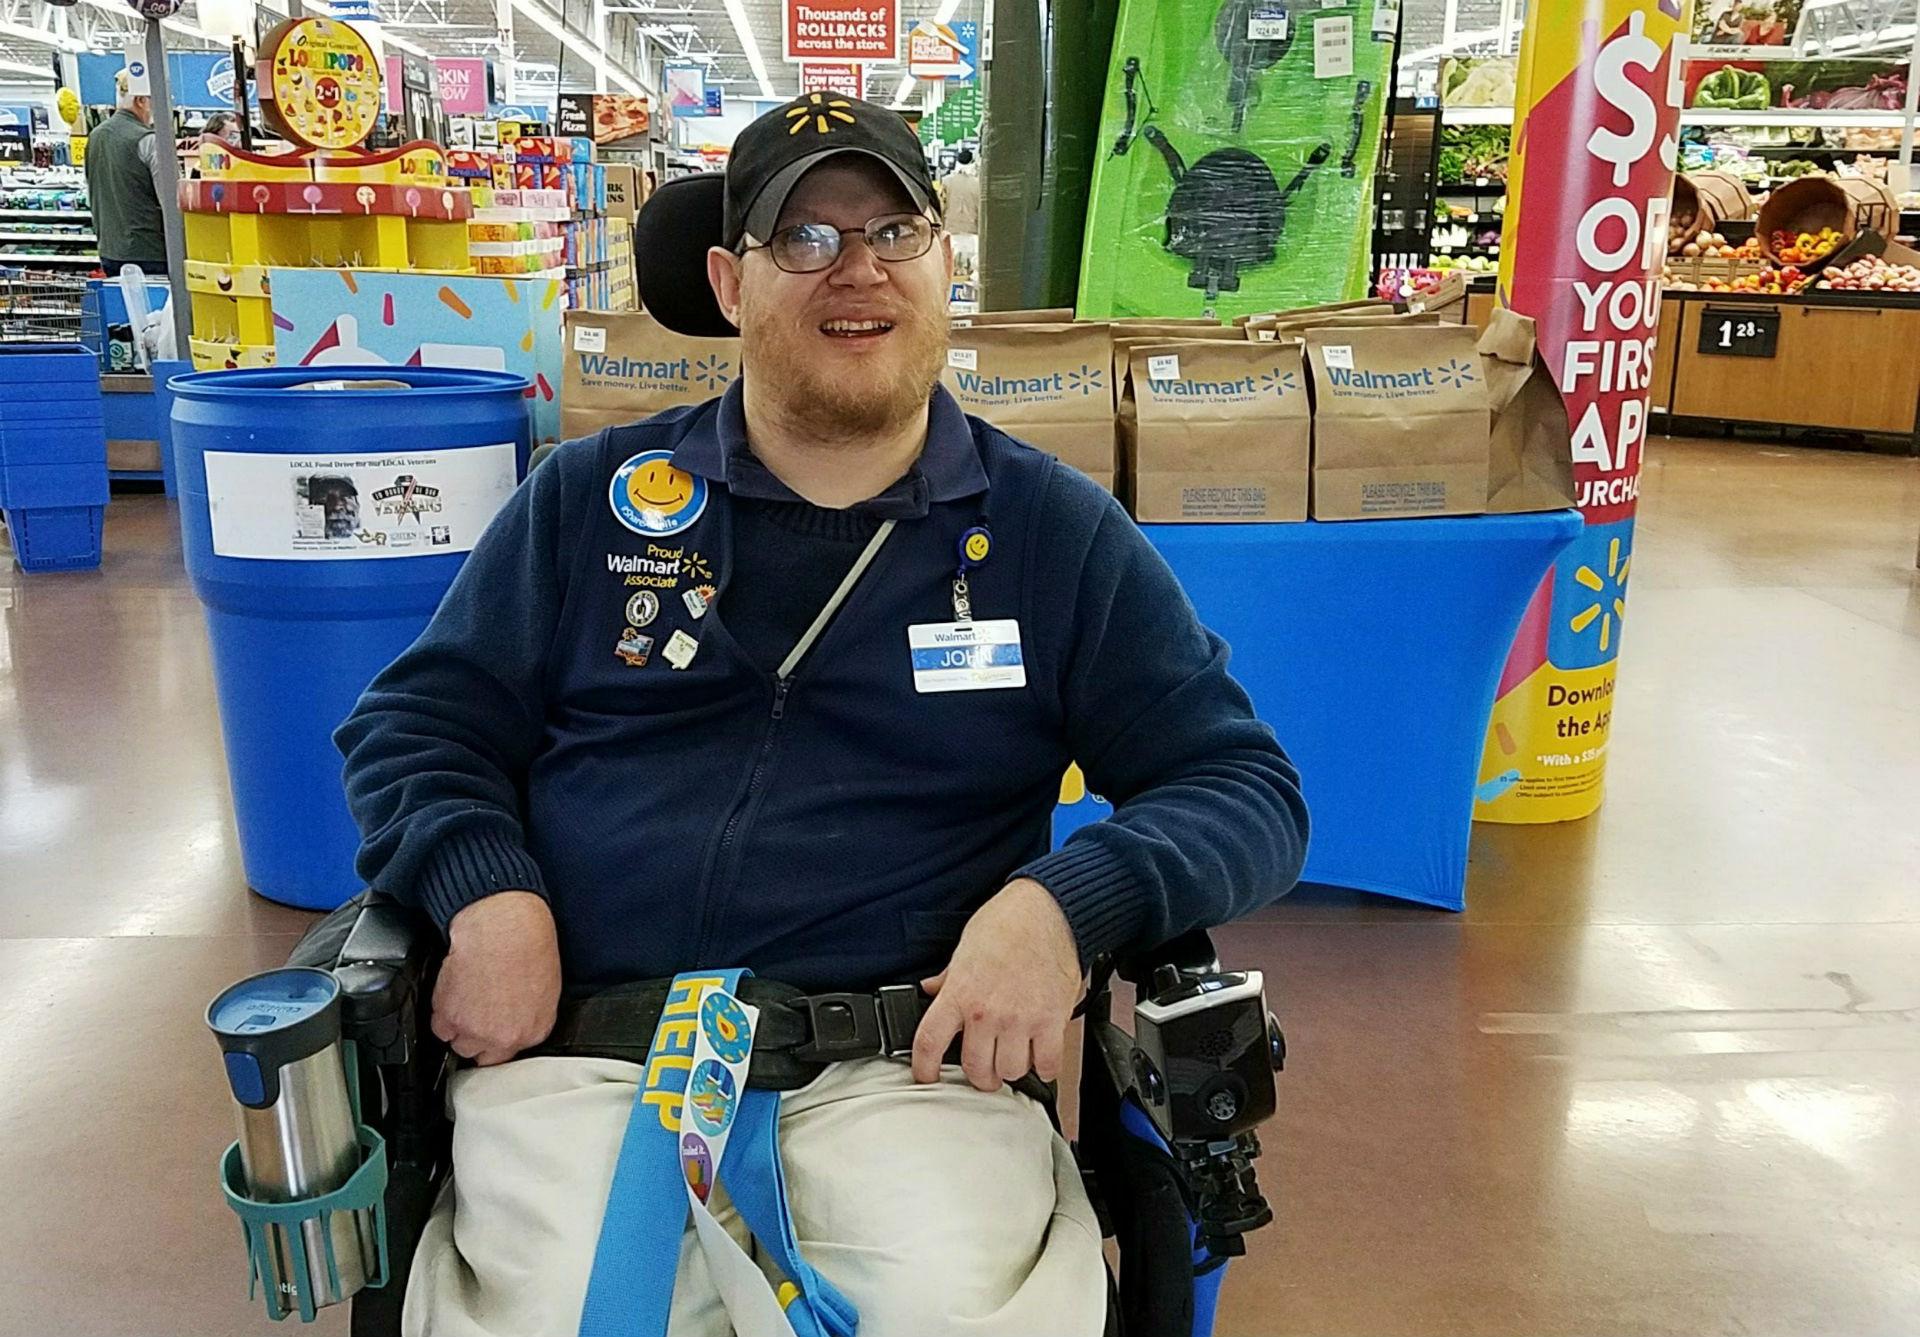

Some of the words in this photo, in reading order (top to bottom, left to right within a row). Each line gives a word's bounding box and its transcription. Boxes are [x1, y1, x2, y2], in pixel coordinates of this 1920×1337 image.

[797, 6, 867, 21] Thousands
[870, 8, 887, 21] of
[797, 22, 887, 37] ROLLBACKS
[797, 39, 833, 49] across
[835, 38, 854, 49] the
[856, 39, 887, 50] store.
[805, 75, 828, 85] LOW
[828, 75, 857, 86] PRICE
[561, 110, 586, 121] Fresh
[561, 121, 587, 132] Pizza
[580, 354, 690, 381] Walmart
[581, 378, 602, 387] Save
[604, 380, 638, 391] money.
[639, 381, 659, 390] Live
[660, 382, 690, 393] better.
[956, 372, 1063, 396] Walmart
[1148, 376, 1257, 395] Walmart
[1326, 367, 1434, 389] Walmart
[960, 394, 979, 403] Save
[981, 397, 1013, 406] money.
[1015, 396, 1033, 404] Live
[1034, 394, 1065, 402] better.
[1332, 389, 1352, 397] Save
[1354, 391, 1384, 399] money.
[1385, 390, 1405, 398] Live
[1183, 488, 1206, 502] PLEASE
[647, 544, 684, 559] Proud
[607, 553, 681, 575] Walmart
[623, 574, 679, 588] Associate
[934, 632, 976, 643] Walmart
[940, 647, 993, 667] JOHN
[1557, 715, 1591, 738] the
[642, 977, 725, 1132] HELP
